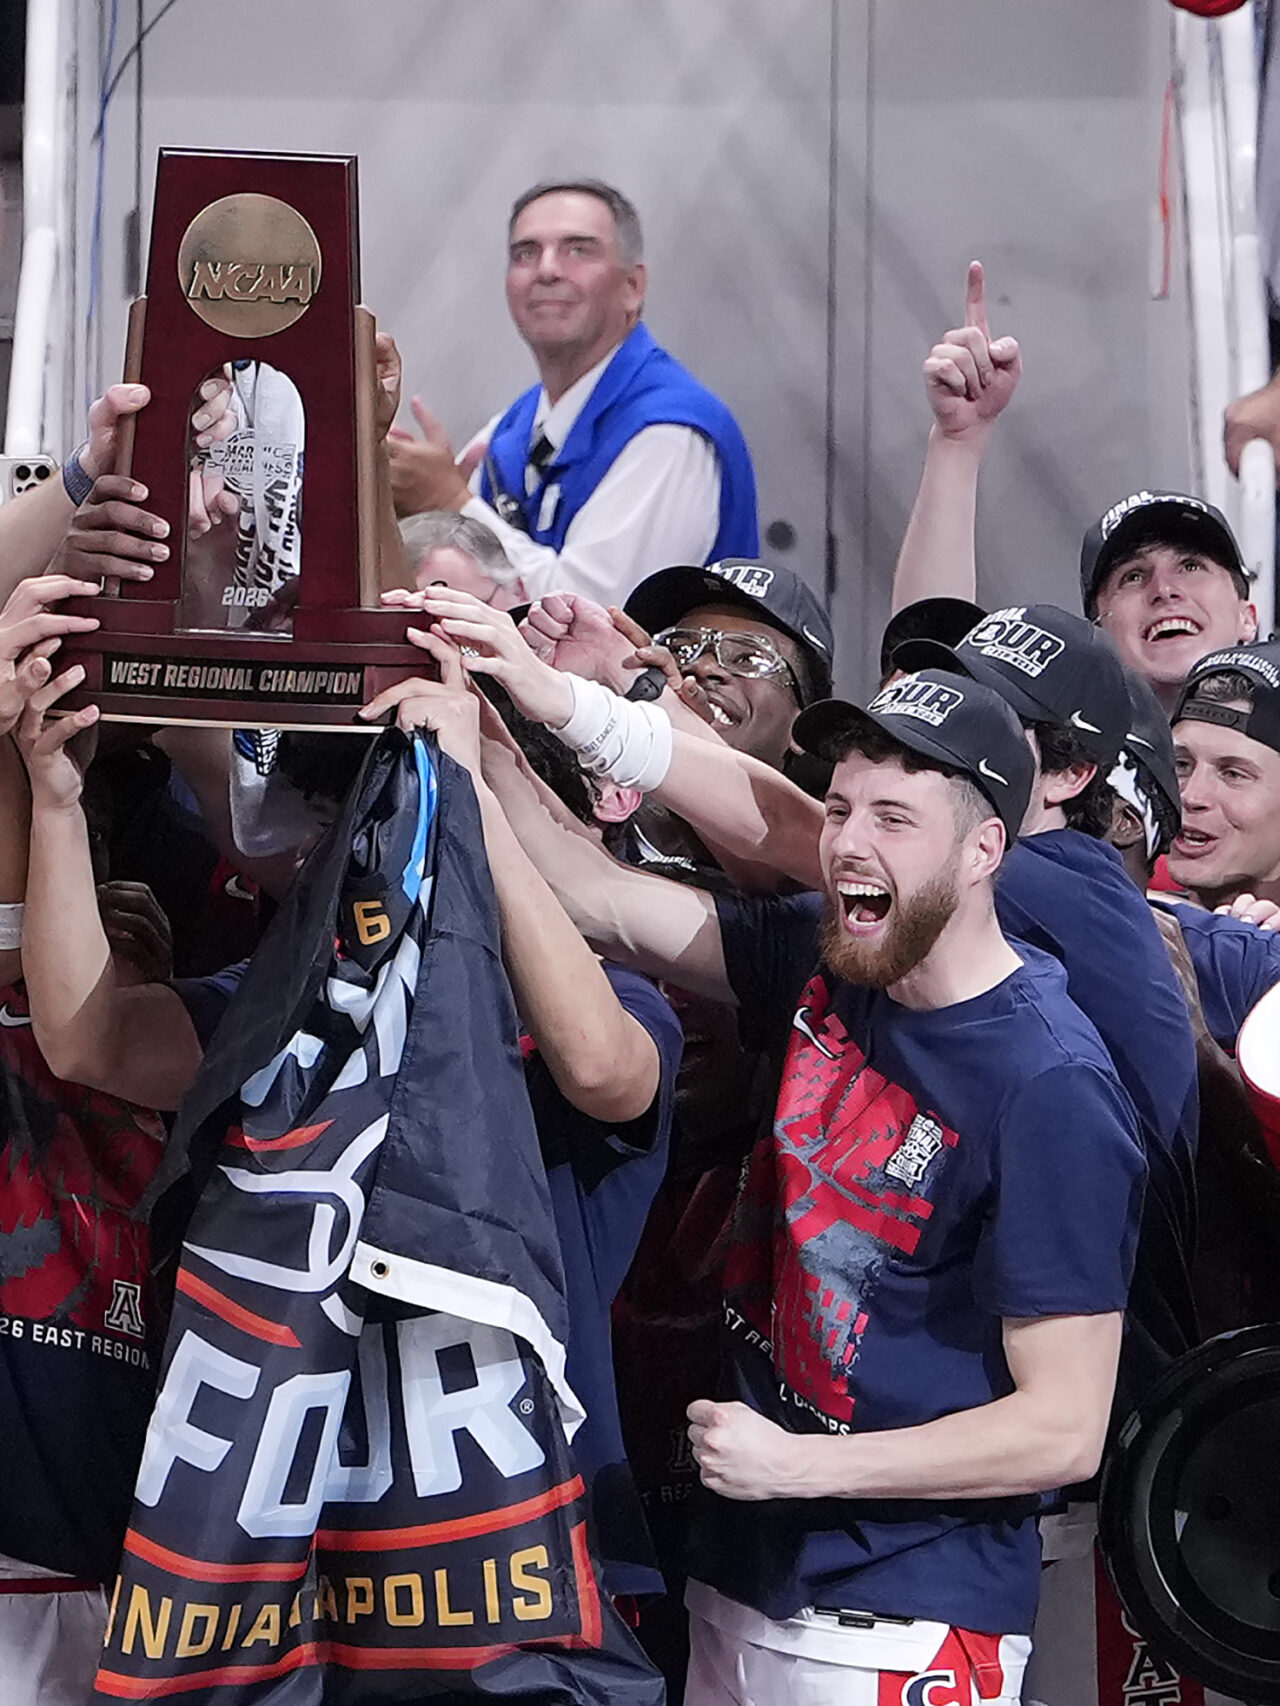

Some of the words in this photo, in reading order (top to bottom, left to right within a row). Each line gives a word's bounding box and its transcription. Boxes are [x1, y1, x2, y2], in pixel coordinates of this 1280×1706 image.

[188, 261, 314, 304] NCAA
[221, 586, 269, 607] 2026
[958, 619, 1066, 669] OUR
[110, 661, 162, 686] WEST
[163, 665, 254, 691] REGIONAL
[258, 669, 362, 695] CHAMPION
[868, 681, 965, 717] OUR
[352, 900, 391, 946] 6
[104, 1279, 146, 1339] A
[723, 1303, 746, 1331] ST
[32, 1323, 87, 1350] EAST
[91, 1335, 151, 1370] REGION
[134, 1312, 547, 1539] FOUR
